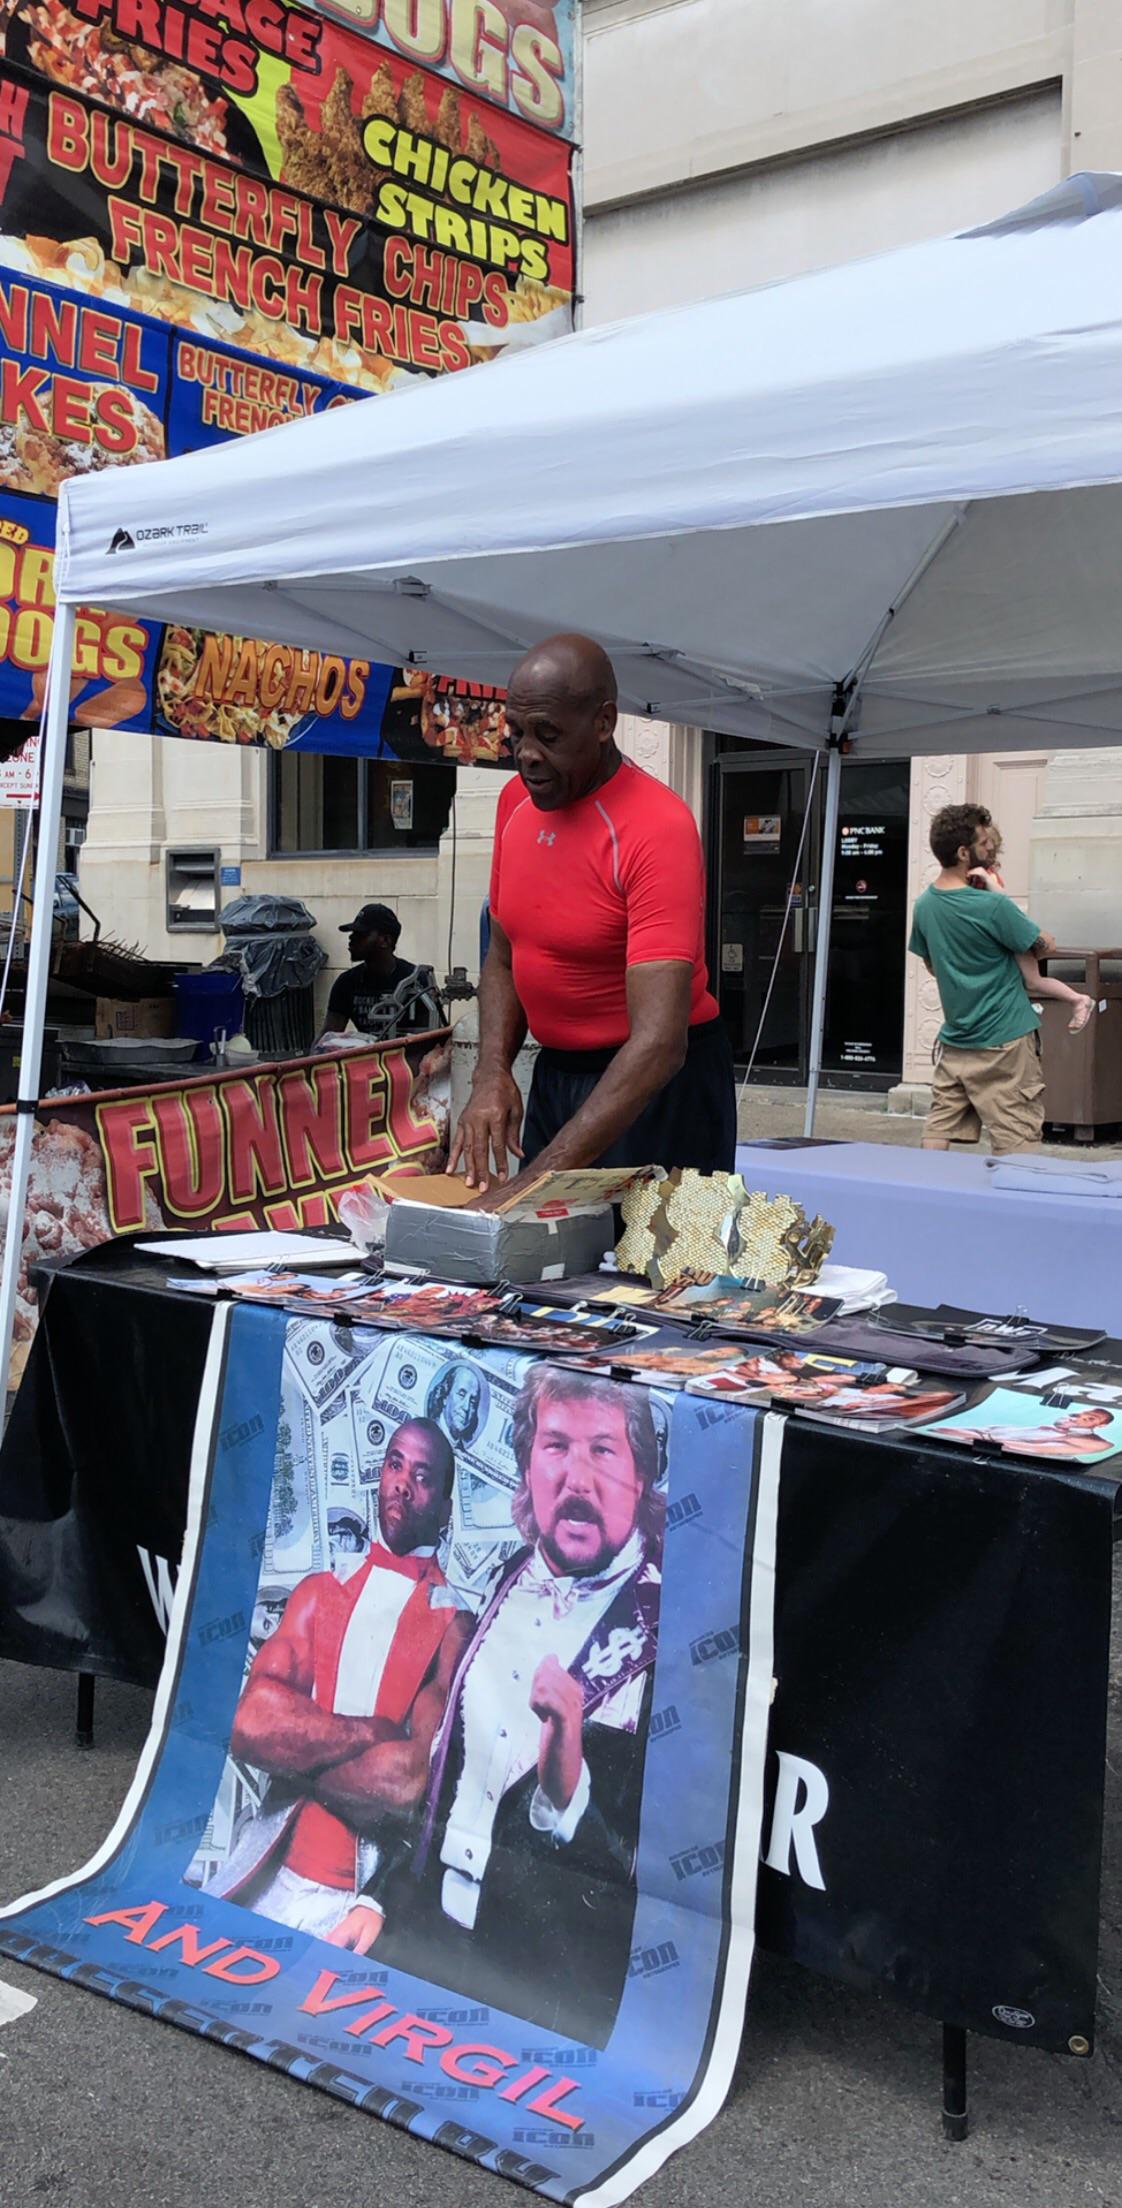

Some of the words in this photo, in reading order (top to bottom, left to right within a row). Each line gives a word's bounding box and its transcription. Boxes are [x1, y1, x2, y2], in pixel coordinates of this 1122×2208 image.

[190, 0, 321, 70] AGE
[312, 0, 564, 126] OGS
[47, 90, 363, 278] BUTTERFLY
[384, 235, 509, 329] CHIPS
[363, 119, 567, 243] CHICKEN
[375, 182, 549, 280] STRIPS
[107, 194, 324, 336] FRENCH
[333, 283, 472, 373] FRIES
[0, 357, 138, 457] KES
[178, 341, 321, 417] BUTTERFLY
[0, 518, 29, 546] ED
[136, 526, 175, 541] OZARK
[176, 523, 208, 536] TRAIL
[0, 606, 146, 679] OGS
[194, 633, 371, 720] NACHOS
[865, 826, 886, 835] BANK
[95, 1047, 441, 1234] FUNNEL
[83, 1900, 282, 1986] AND
[297, 1968, 586, 2133] VIRGIL
